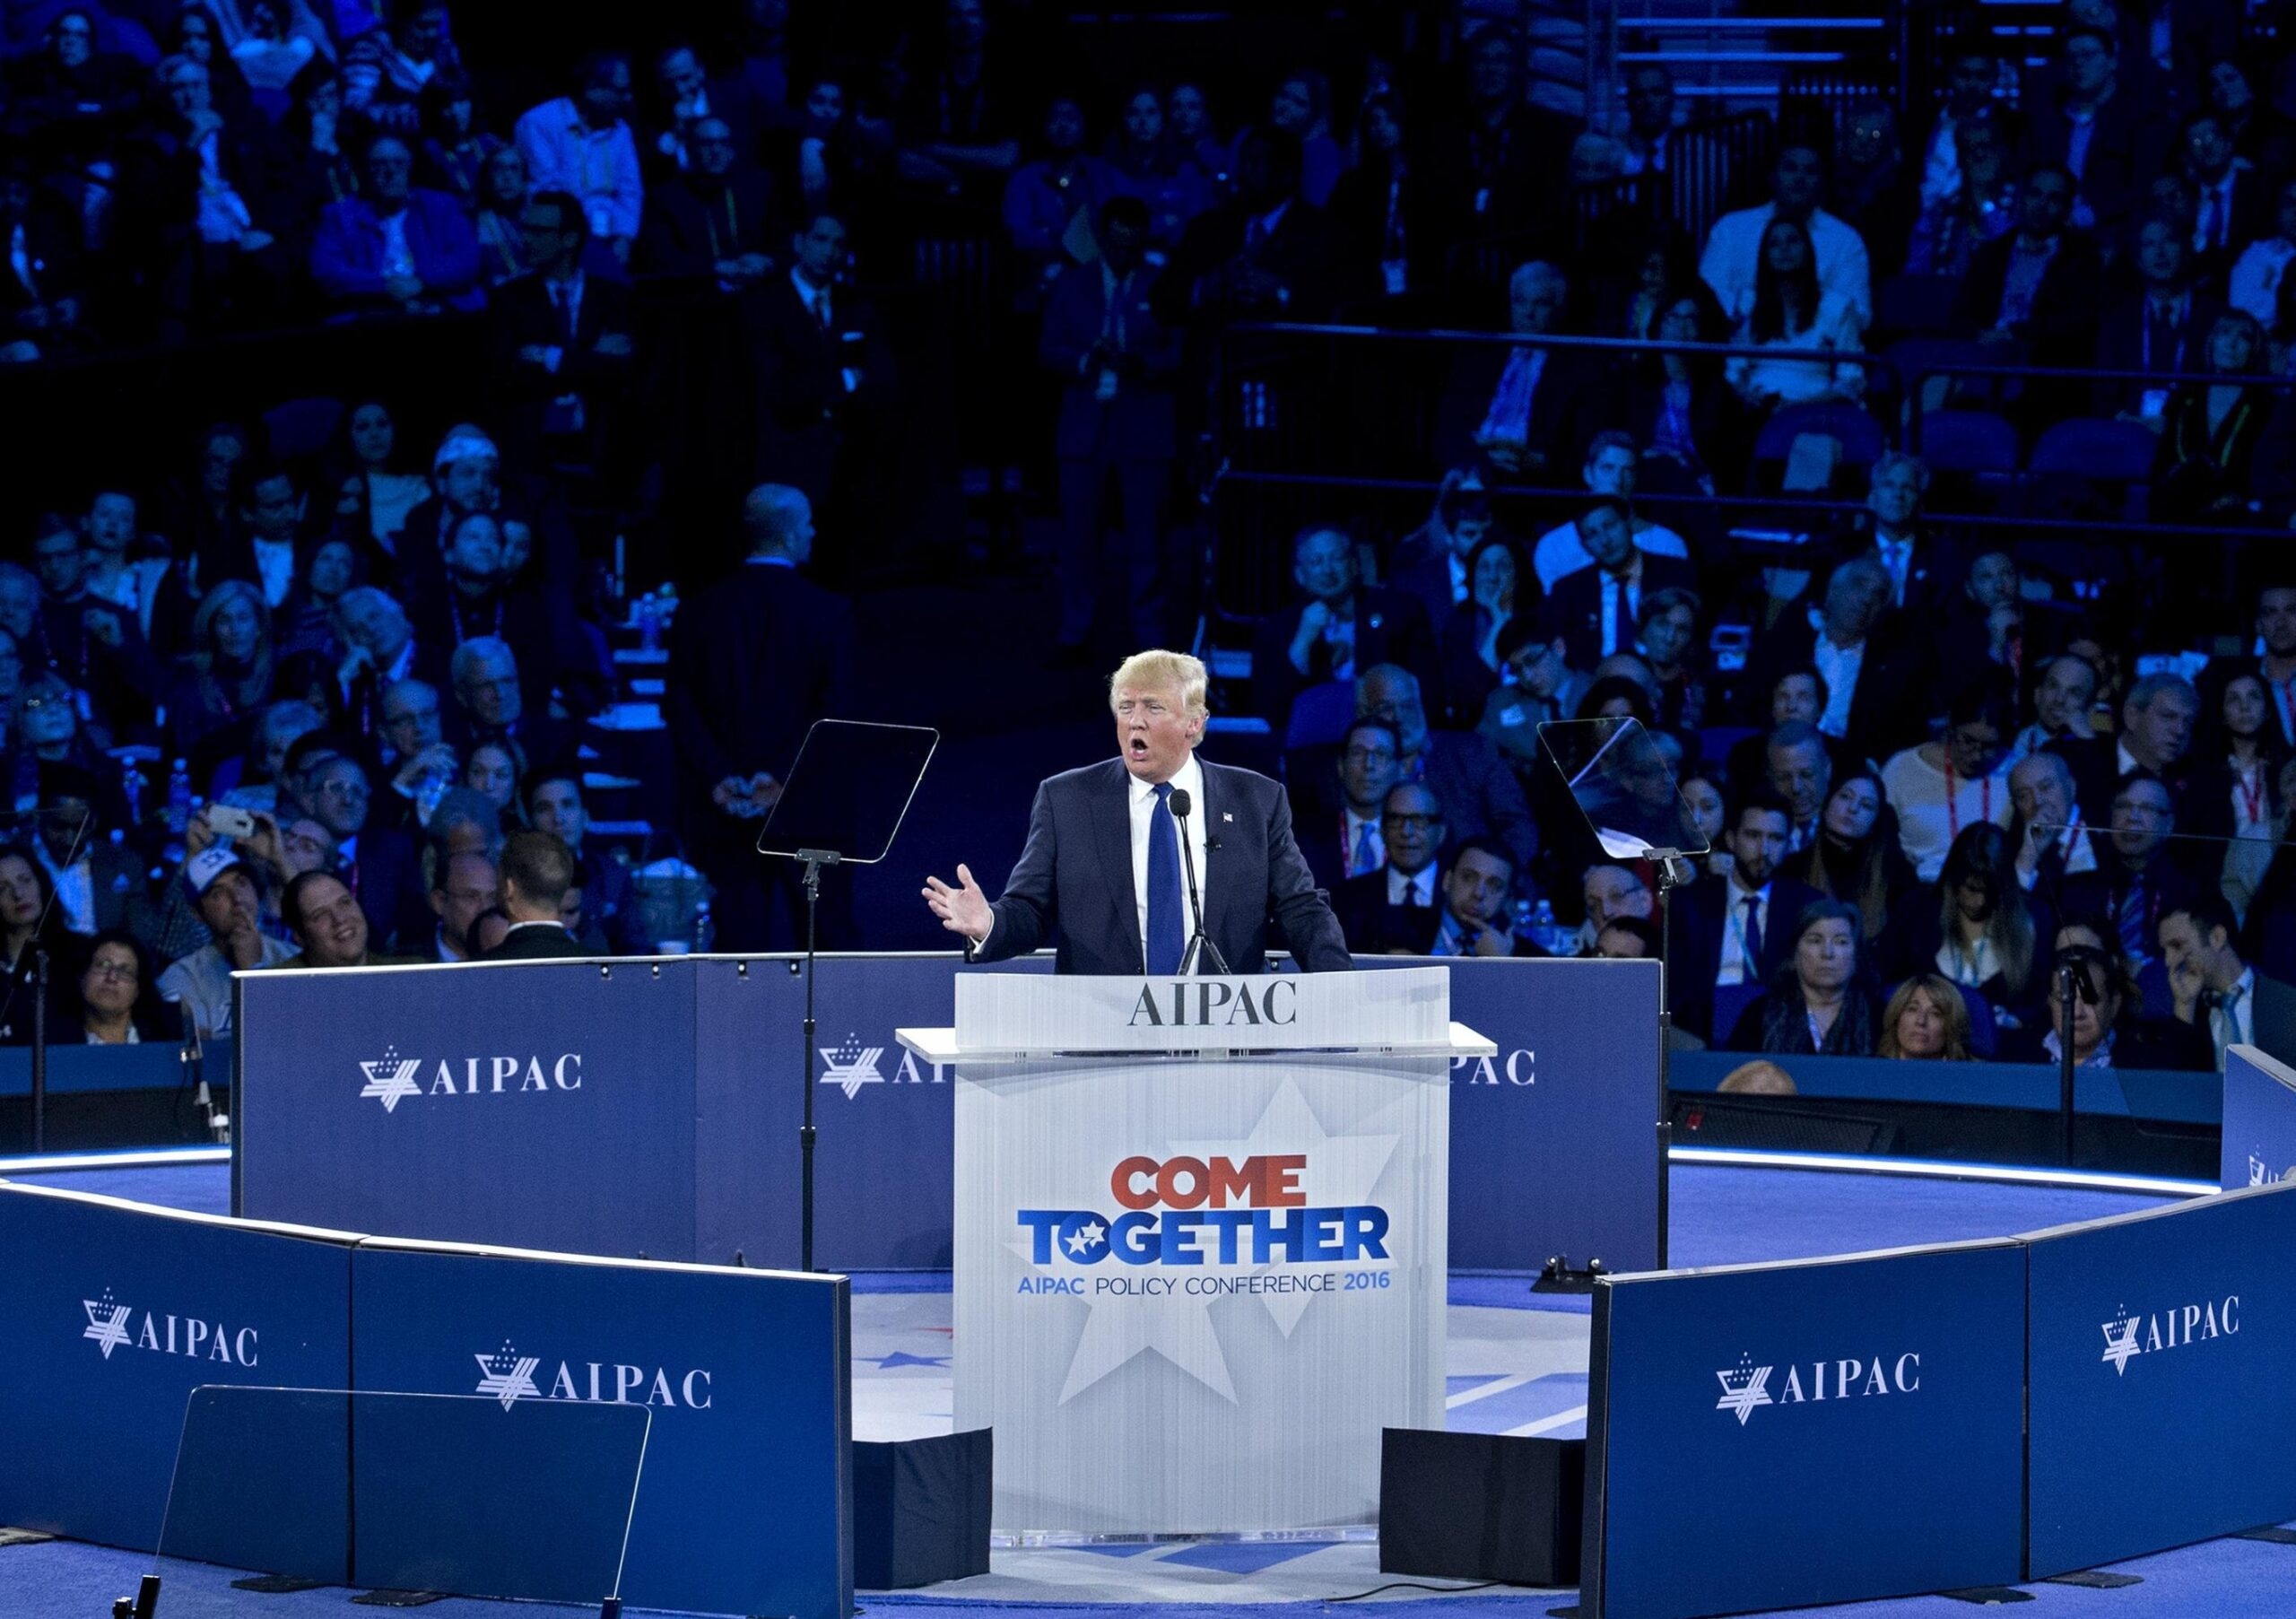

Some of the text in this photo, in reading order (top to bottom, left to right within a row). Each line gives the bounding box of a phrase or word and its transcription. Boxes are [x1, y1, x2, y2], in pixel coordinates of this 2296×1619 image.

[1126, 980, 1297, 1026] AIPAC
[429, 1054, 581, 1095] AIPAC
[1111, 1154, 1307, 1210] COME
[1017, 1206, 1390, 1266] TOGETHER
[1017, 1271, 1391, 1296] AIPAC POLICY CONFERENCE 2016
[137, 1311, 258, 1368] AIPAC
[2145, 1295, 2239, 1353] AIPAC
[548, 1360, 711, 1409] AIPAC
[1779, 1353, 1919, 1405] AIPAC
